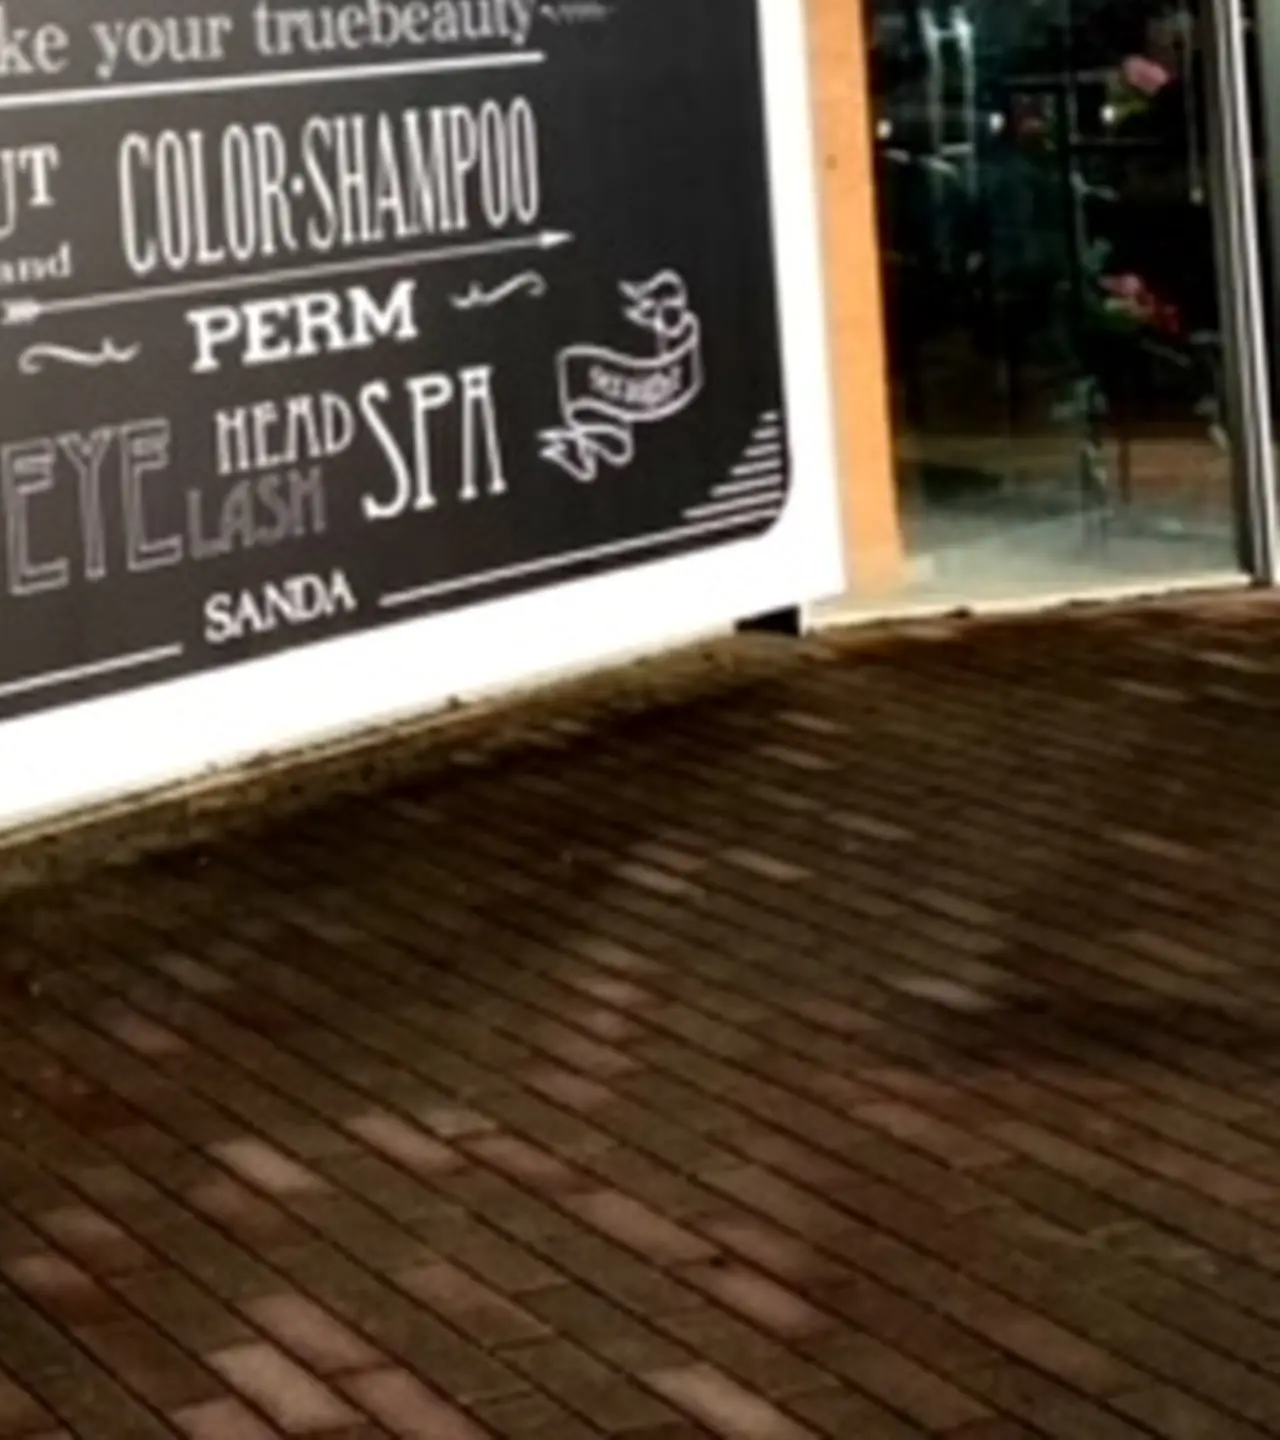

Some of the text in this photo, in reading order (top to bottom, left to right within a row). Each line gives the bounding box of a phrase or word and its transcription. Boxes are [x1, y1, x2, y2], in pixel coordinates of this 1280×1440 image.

[90, 8, 235, 81] your
[187, 278, 419, 373] PERM
[213, 363, 510, 523] HEAD SPA
[202, 565, 359, 646] SANDA
